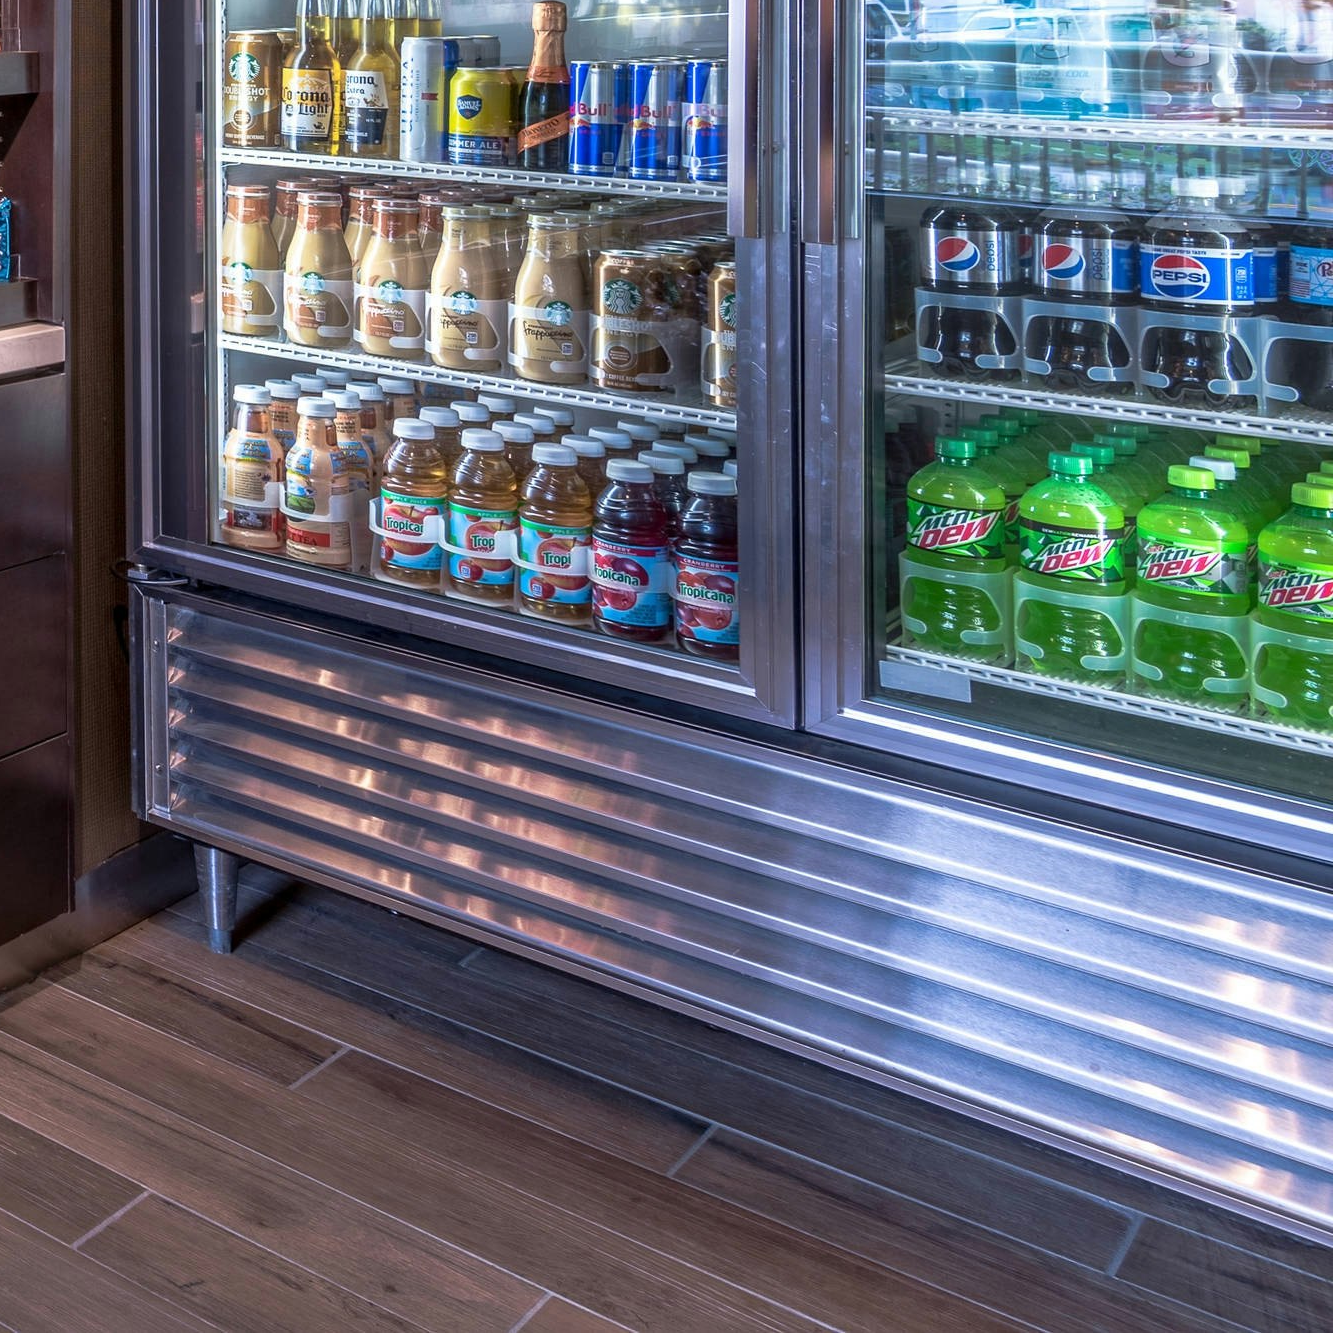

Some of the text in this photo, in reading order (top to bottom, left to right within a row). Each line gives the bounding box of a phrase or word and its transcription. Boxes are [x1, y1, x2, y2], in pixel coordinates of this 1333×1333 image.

[298, 103, 329, 116] Light
[578, 103, 607, 116] Bull
[480, 141, 499, 149] ALE
[985, 240, 996, 273] pepsi
[1092, 247, 1103, 281] pepsi
[1153, 269, 1208, 284] PEPSI
[299, 535, 318, 546] TEA
[595, 540, 631, 553] CRANBERRY
[683, 558, 725, 569] CRANBERRY
[679, 583, 734, 604] Tropicana
